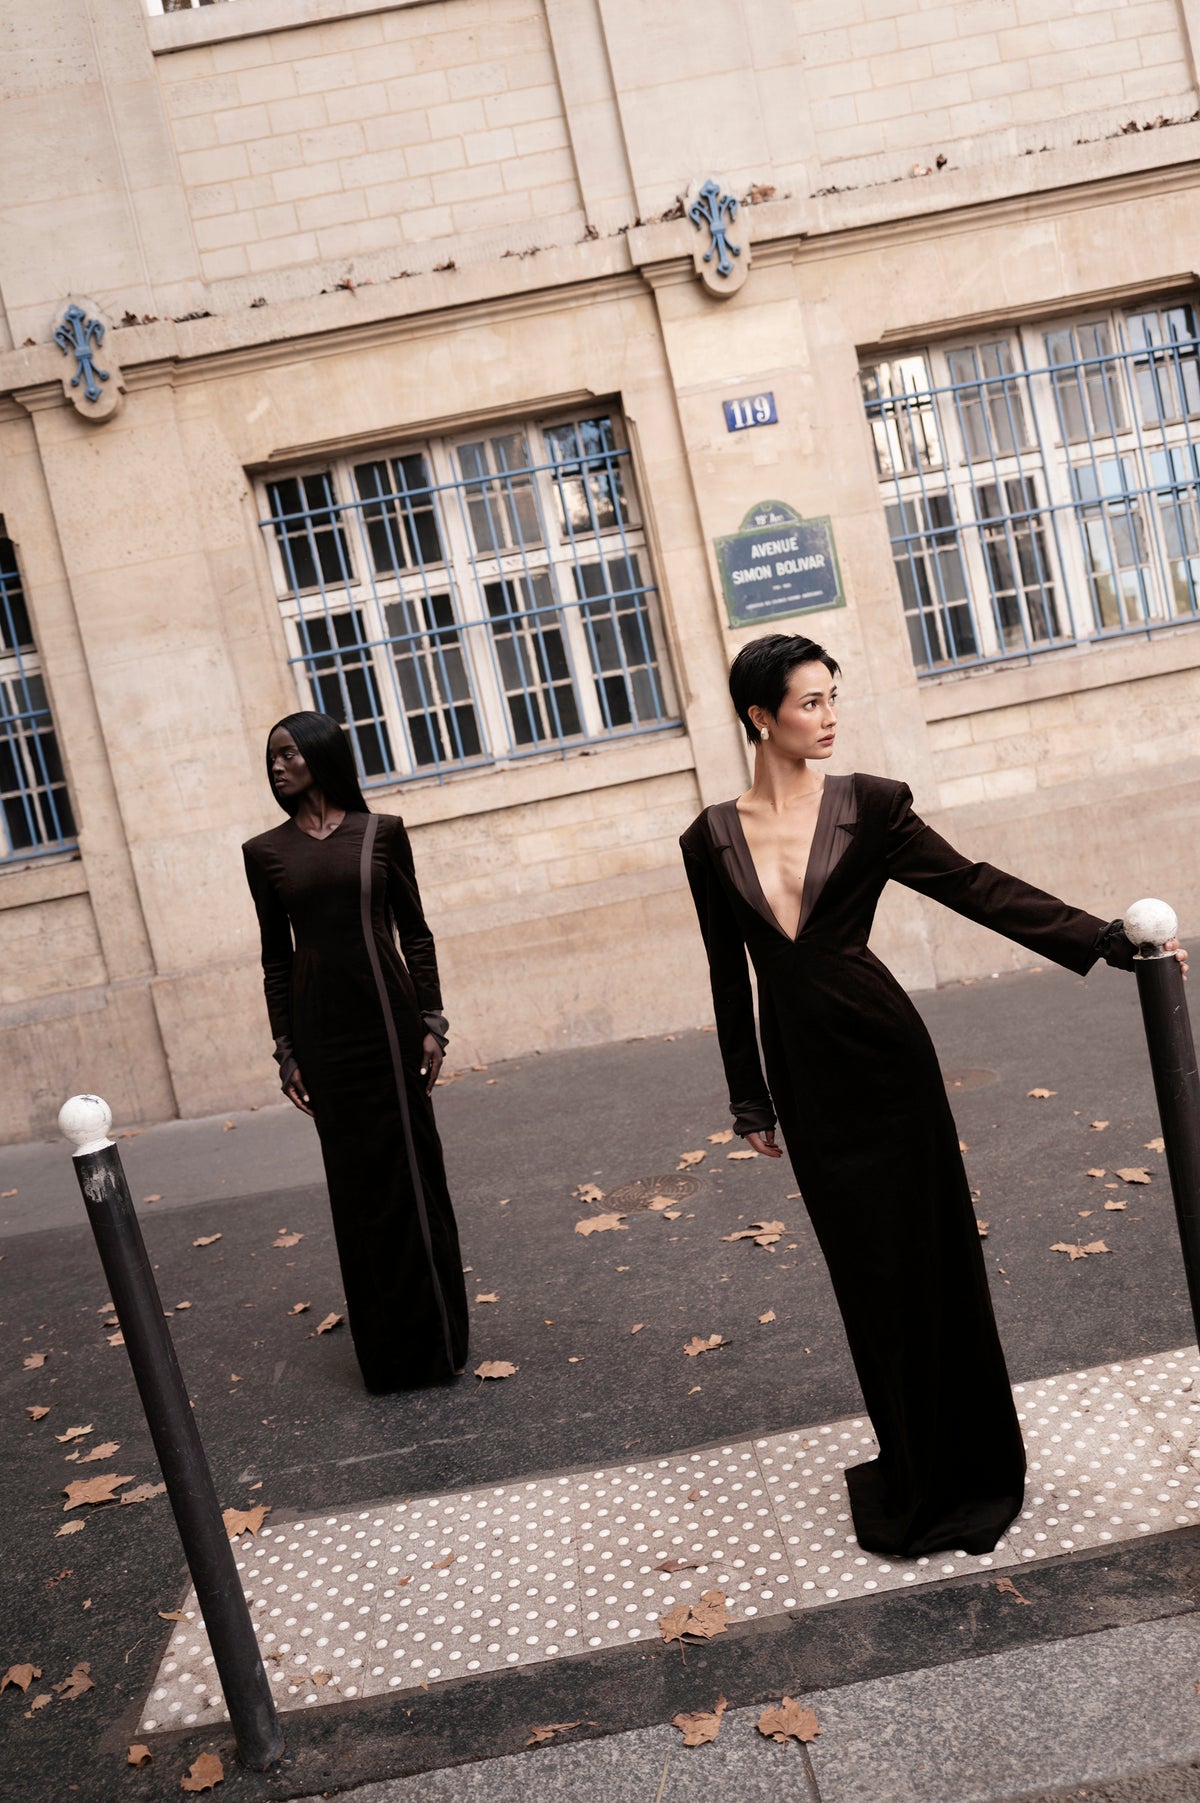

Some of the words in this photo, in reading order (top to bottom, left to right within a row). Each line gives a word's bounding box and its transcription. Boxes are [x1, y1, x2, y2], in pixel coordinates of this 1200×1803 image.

[731, 396, 771, 428] 119
[751, 536, 799, 559] AVENUE
[732, 564, 773, 585] SIMON
[775, 554, 826, 577] BOLIVAR
